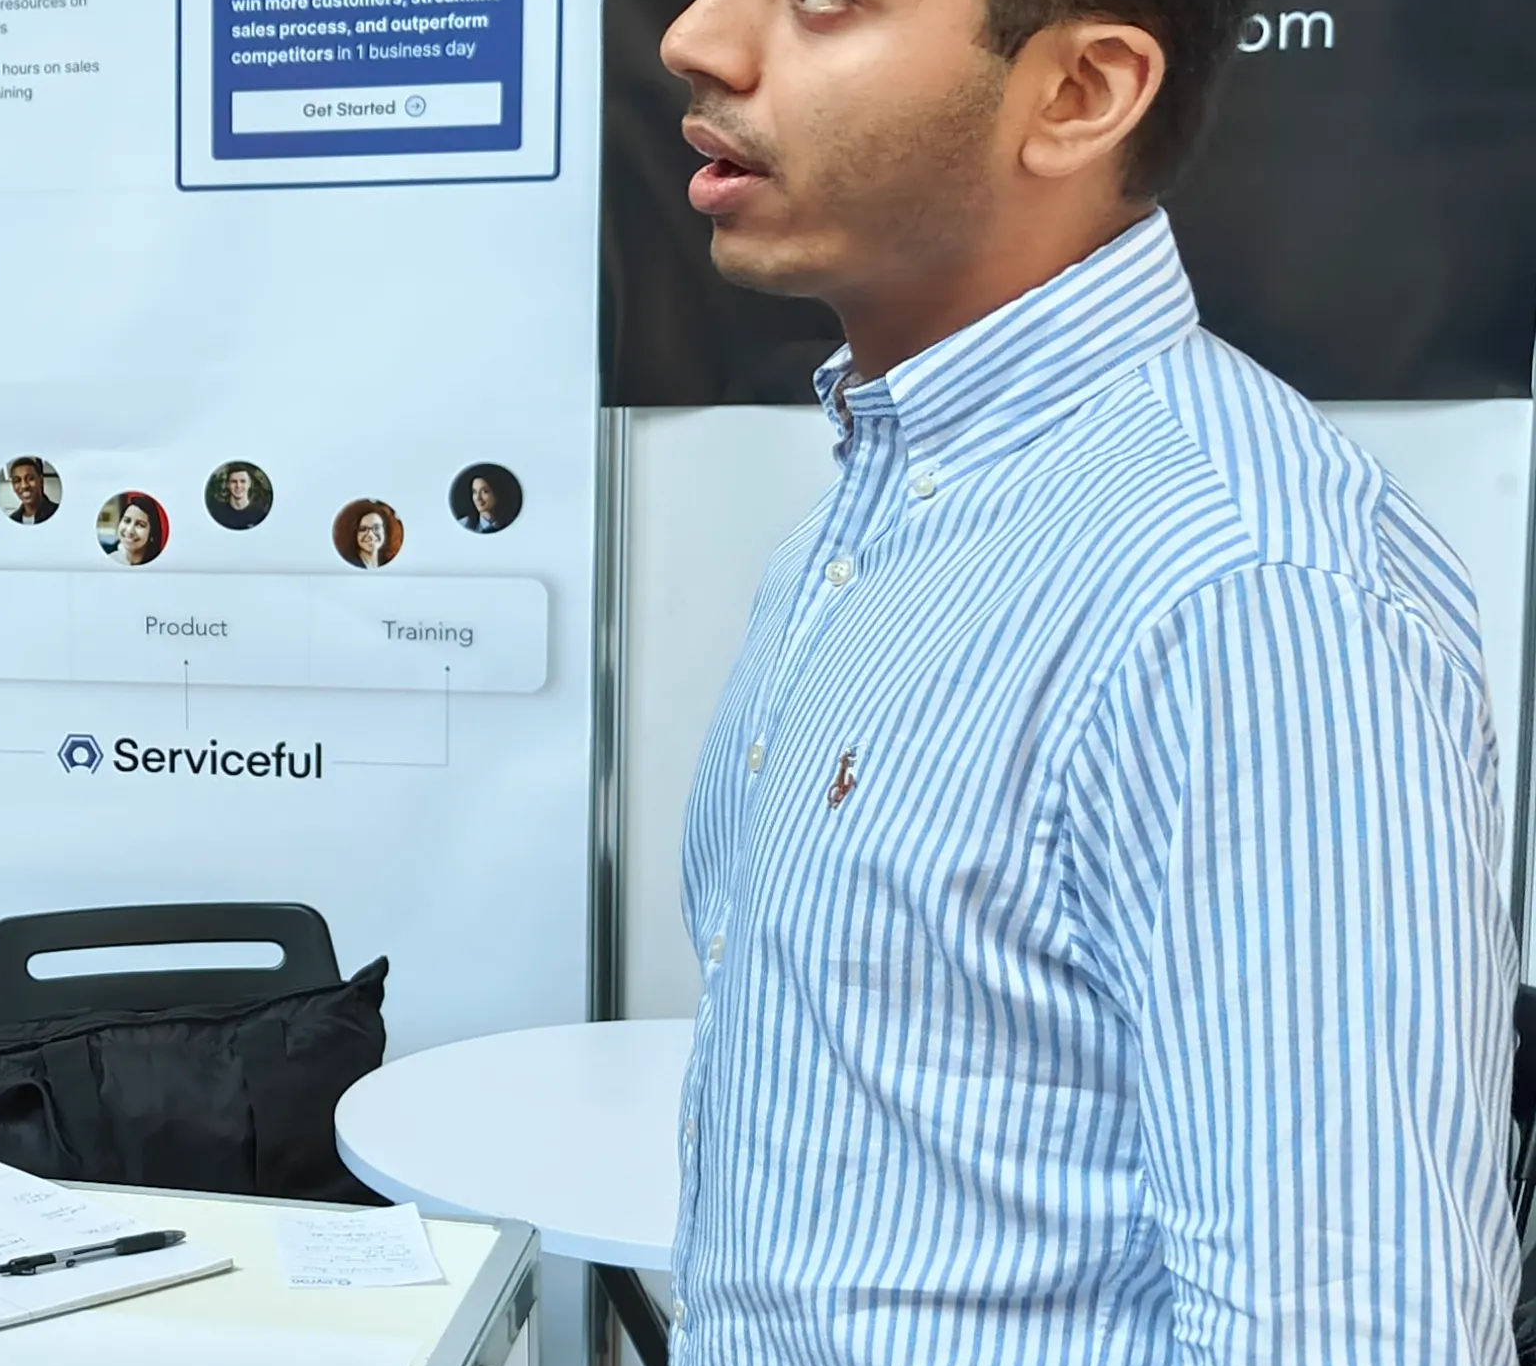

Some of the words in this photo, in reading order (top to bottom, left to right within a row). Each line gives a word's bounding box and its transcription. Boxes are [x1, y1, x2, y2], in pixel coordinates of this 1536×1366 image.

[231, 21, 276, 38] sales
[278, 20, 351, 40] process,
[354, 17, 387, 34] and
[390, 12, 489, 34] outperform
[231, 45, 333, 67] competitors
[336, 45, 351, 60] in
[355, 44, 364, 60] 1
[368, 40, 440, 59] business
[445, 39, 476, 59] day
[2, 62, 40, 76] hours
[43, 62, 61, 75] on
[64, 60, 99, 74] sales
[302, 103, 332, 118] Get
[336, 99, 396, 117] Started
[144, 616, 229, 638] Product
[382, 620, 475, 647] Training
[112, 737, 324, 780] Serviceful
